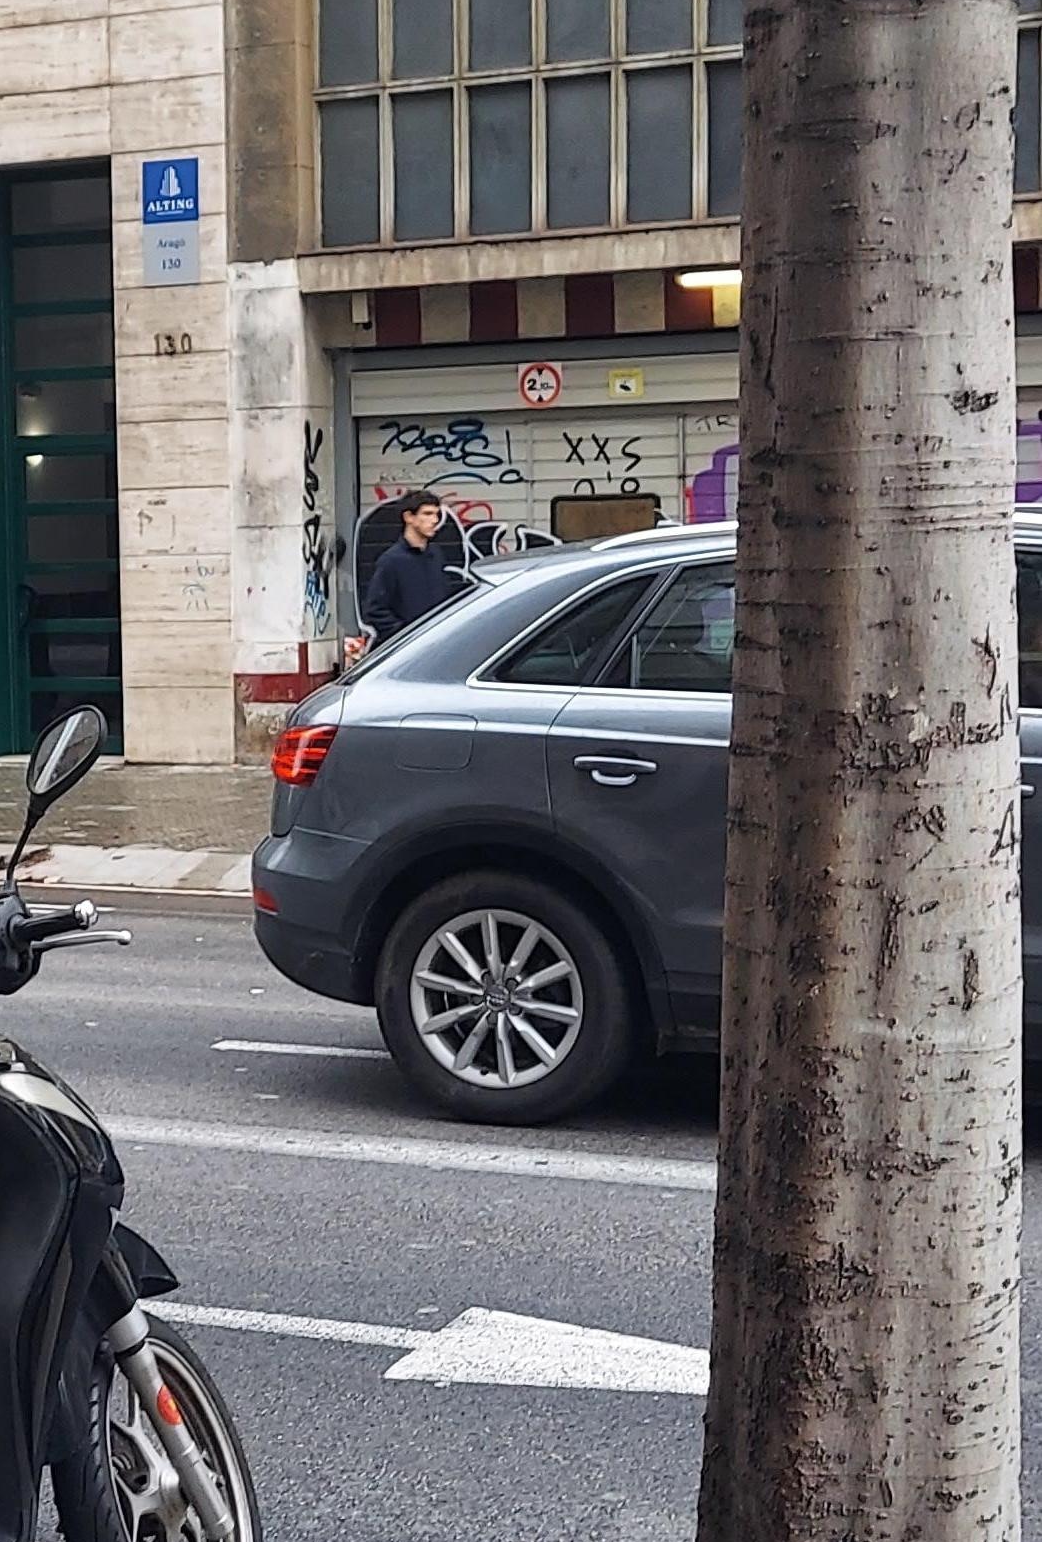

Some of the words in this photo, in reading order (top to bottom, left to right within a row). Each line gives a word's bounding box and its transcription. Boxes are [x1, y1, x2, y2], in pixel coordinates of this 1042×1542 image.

[147, 198, 195, 212] ALTING
[162, 258, 181, 270] 130
[154, 332, 193, 357] 130
